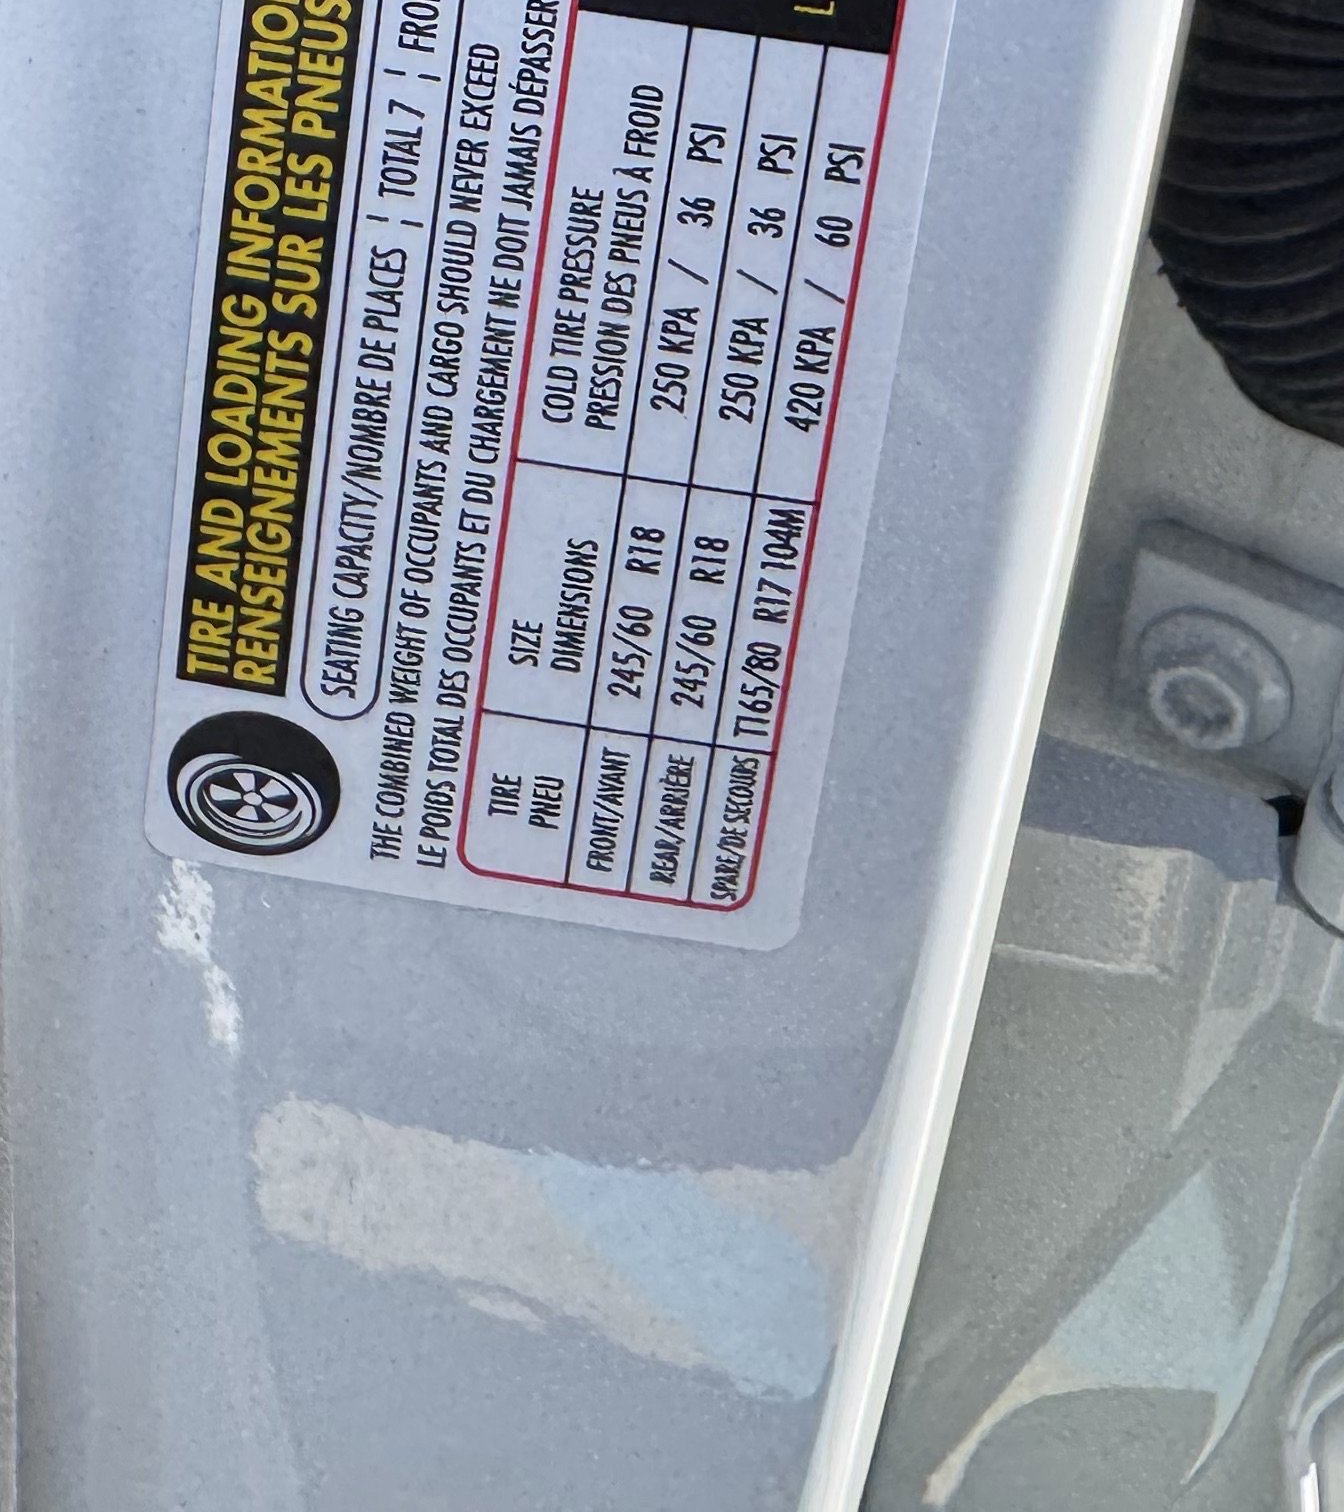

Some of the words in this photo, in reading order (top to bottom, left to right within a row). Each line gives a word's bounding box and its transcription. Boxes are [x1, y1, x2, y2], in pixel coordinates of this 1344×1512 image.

[386, 97, 426, 121] 7
[458, 42, 501, 133] EXCEED
[622, 83, 665, 159] FROID
[685, 121, 728, 166] PSI
[376, 125, 424, 199] TOTAL
[448, 137, 491, 214] NEVER
[500, 120, 544, 213] JAMAIS
[755, 132, 799, 176] PSI
[823, 141, 867, 186] PSI
[281, 151, 335, 223] LES
[675, 195, 717, 230] 36
[491, 211, 531, 273] DOIT
[556, 185, 605, 305] PRESSURE
[606, 186, 650, 266] PNEUS
[746, 206, 787, 240] 36
[813, 214, 855, 249] 60
[270, 233, 325, 320] SUR
[361, 244, 409, 335] PLACES
[435, 218, 478, 316] SHOULD
[486, 274, 523, 310] NE
[599, 269, 638, 318] DES
[356, 336, 398, 373] DE
[425, 320, 466, 399] CARGO
[548, 306, 588, 358] TIRE
[656, 305, 701, 356] KPA
[725, 316, 771, 367] KPA
[792, 325, 837, 376] KPA
[203, 293, 269, 488] LOADING
[467, 310, 518, 466] CHARGEMENT
[540, 364, 580, 425] COLD
[583, 319, 632, 432] PRESSION
[648, 361, 692, 415] 250
[717, 371, 760, 426] 250
[417, 404, 455, 457] AND
[783, 381, 826, 434] 420
[232, 328, 315, 686] RENSEIGNEMENTS
[330, 374, 393, 600] CAPACITY/NOMBRE
[460, 469, 497, 506] DU
[194, 497, 245, 593] AND
[402, 457, 449, 586] OCCUPANTS
[457, 506, 492, 536] ET
[623, 525, 667, 577] R18
[759, 507, 807, 572] 104M
[688, 535, 731, 586] R18
[397, 586, 432, 620] OF
[441, 539, 488, 664] OCCUPANTS
[548, 536, 600, 674] DIMENSIONS
[751, 575, 794, 626] R17
[185, 597, 236, 675] TIRE
[319, 605, 366, 700] SEATING
[387, 620, 429, 705] WEIGHT
[506, 618, 545, 669] SIZE
[605, 604, 655, 701] 245/60
[668, 613, 718, 710] 245/60
[434, 667, 471, 711] DES
[731, 640, 783, 739] T165/80
[374, 710, 417, 820] COMBINED
[426, 714, 466, 774] TOTAL
[417, 777, 457, 843] POIDS
[486, 771, 523, 818] TIRE
[527, 774, 566, 831] PNEU
[584, 745, 632, 874] FRONT/AVANT
[368, 820, 404, 861] THE
[415, 843, 448, 870] LE
